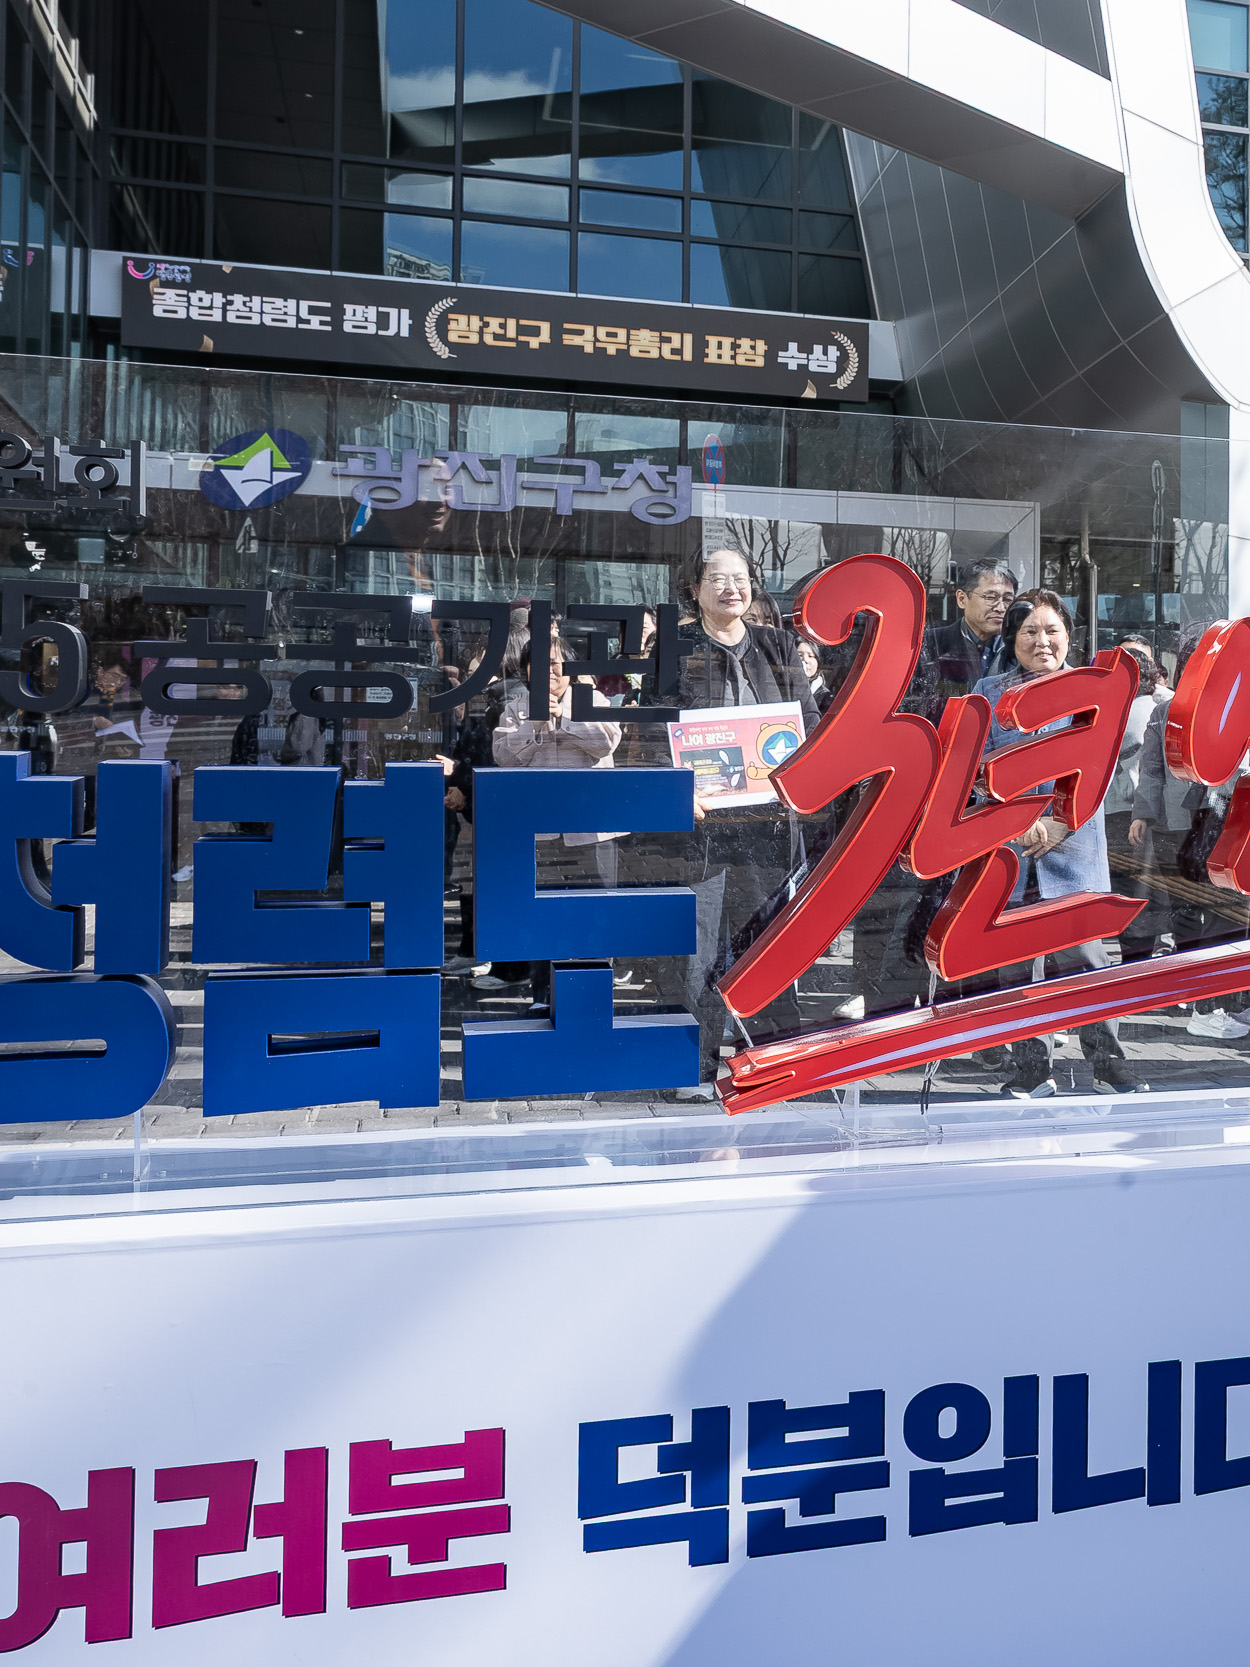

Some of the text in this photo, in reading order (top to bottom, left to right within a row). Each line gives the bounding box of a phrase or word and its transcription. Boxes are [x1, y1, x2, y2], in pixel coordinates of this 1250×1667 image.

[152, 287, 840, 374] 종합청렴도 평가 광진구 국무총리 표창 수상
[331, 444, 693, 526] 광진구청
[133, 583, 695, 723] 공공기관
[0, 1427, 512, 1654] 여러분
